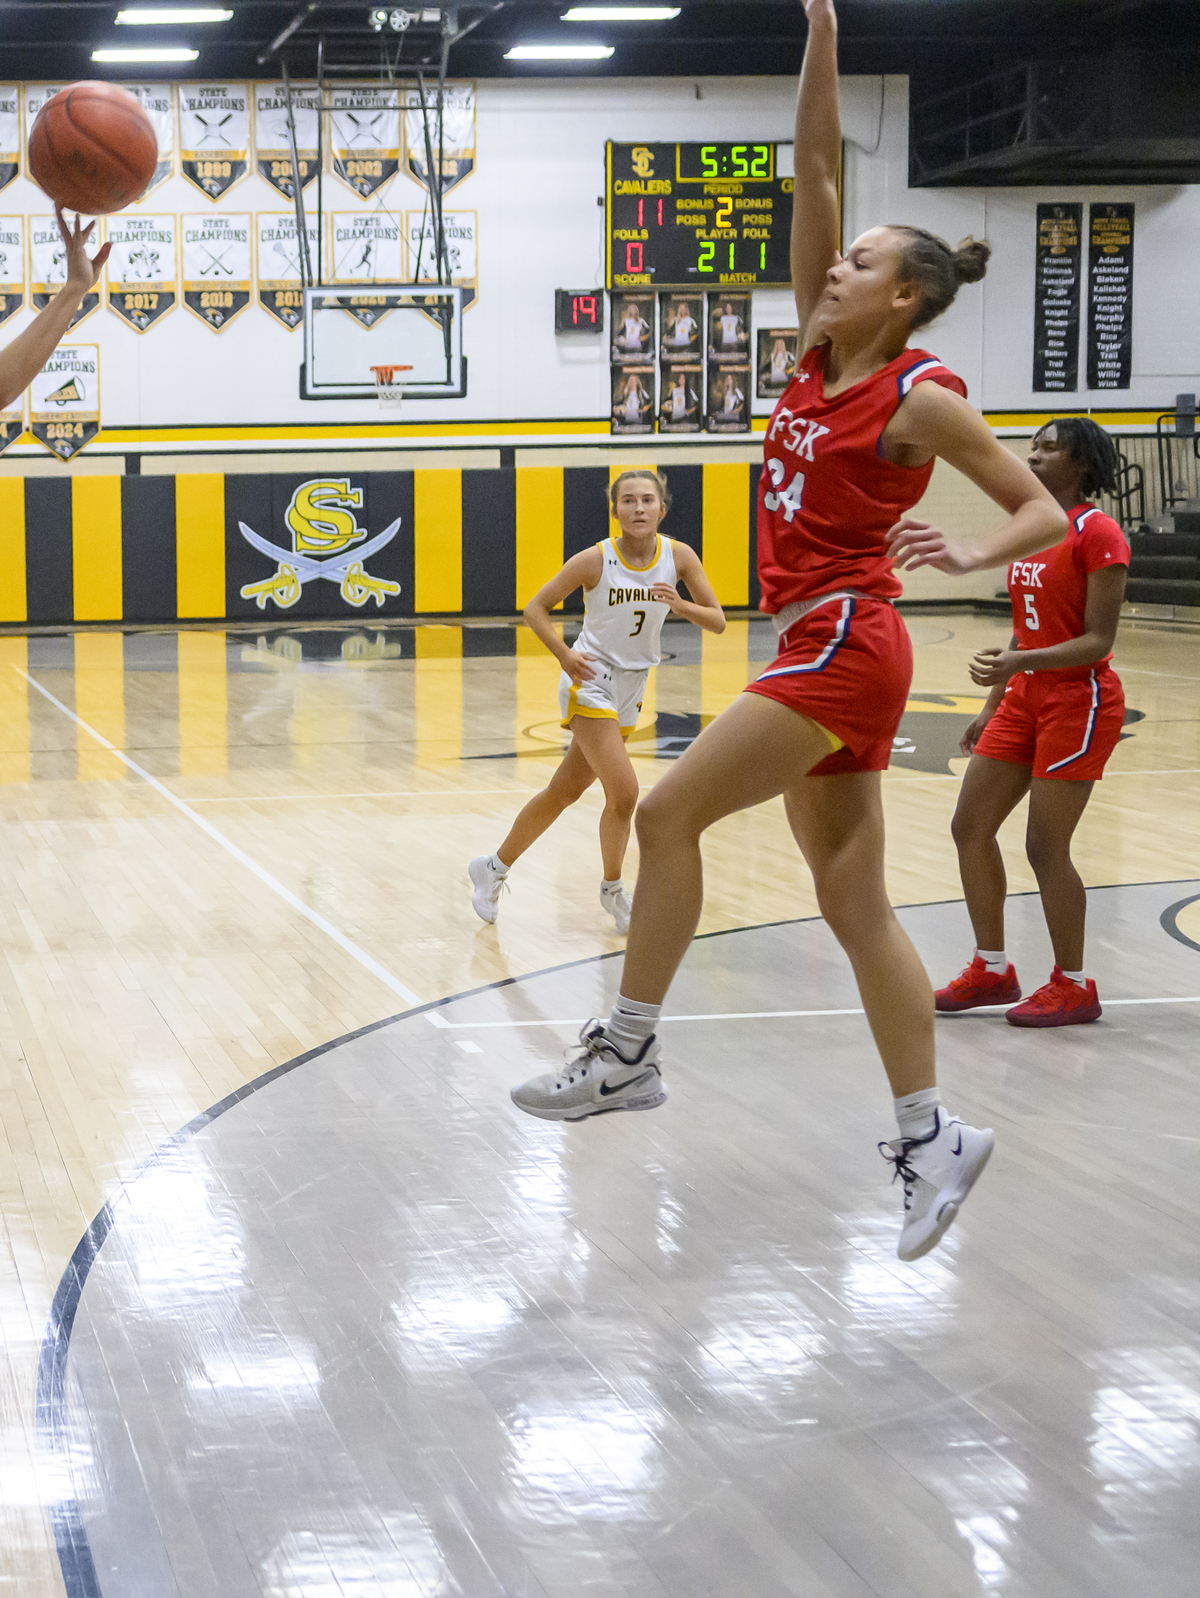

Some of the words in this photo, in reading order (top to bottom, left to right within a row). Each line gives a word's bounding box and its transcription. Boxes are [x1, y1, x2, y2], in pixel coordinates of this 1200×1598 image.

[200, 87, 227, 97] STATE
[700, 145, 768, 178] 5:52
[271, 160, 308, 177] 200
[346, 160, 382, 177] 2002
[613, 179, 672, 195] CAVALIERS
[703, 183, 743, 195] PERIOD
[676, 198, 714, 210] BONUS
[735, 198, 773, 209] BONUS
[637, 198, 663, 227] 11
[715, 196, 733, 228] 2
[127, 219, 154, 229] STATE
[203, 218, 230, 228] STATE
[353, 216, 380, 226] STATE
[676, 214, 707, 226] POSS
[742, 214, 773, 225] POSS
[109, 230, 173, 244] CHAMPIONS
[185, 229, 248, 243] CHAMPIONS
[336, 227, 399, 241] CHAMPIONS
[613, 229, 649, 240] FOULS
[695, 228, 737, 239] PLAYER
[743, 228, 771, 239] FOUL
[626, 242, 643, 273] 0
[613, 273, 651, 286] SCORE
[719, 273, 757, 284] MATCH
[124, 294, 159, 310] 2017
[1093, 295, 1127, 304] Kennedy
[1096, 304, 1123, 313] Knight
[1094, 314, 1125, 323] Murphy
[1095, 323, 1122, 332] Phelps
[1097, 342, 1122, 351] Taylor
[1100, 351, 1118, 359] Trail
[1097, 361, 1121, 369] White
[1097, 380, 1118, 388] Wink
[35, 411, 95, 421] CHEERLEADING
[46, 422, 85, 439] 2024
[769, 407, 830, 462] FSK
[763, 457, 805, 523] 34
[1011, 561, 1046, 588] FSK
[1023, 593, 1040, 631] 5
[629, 610, 646, 637] 3
